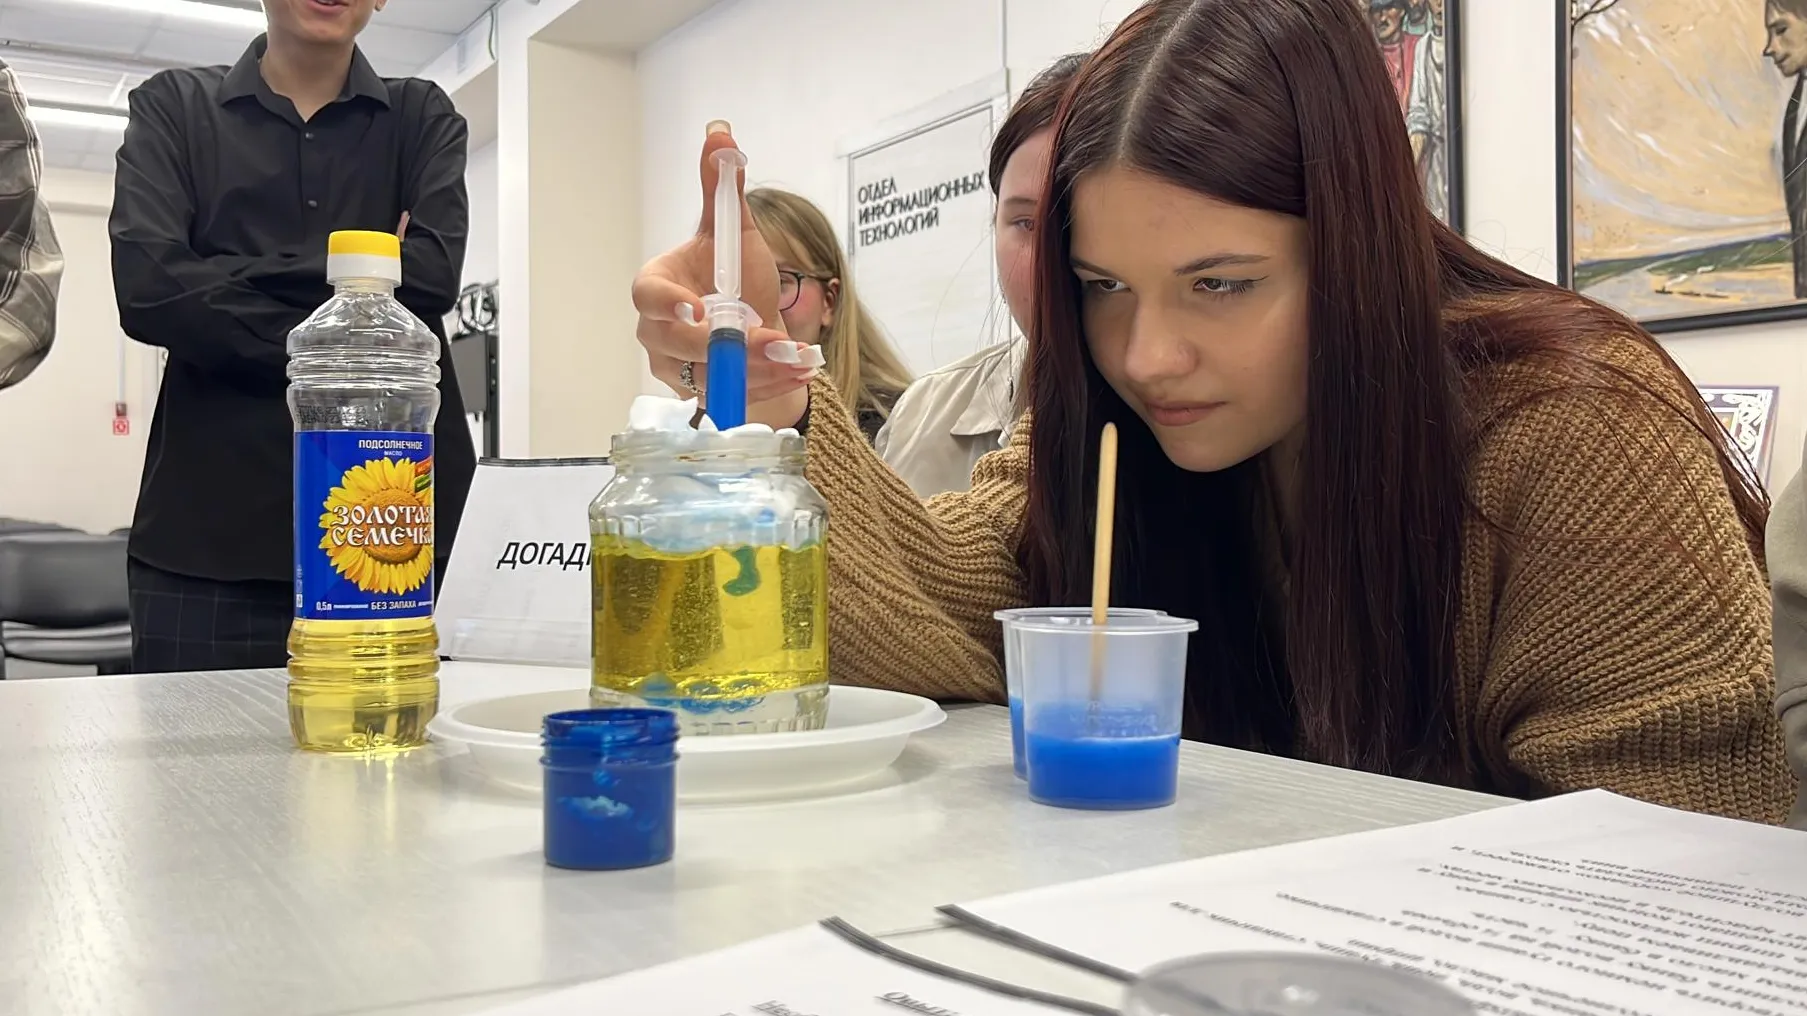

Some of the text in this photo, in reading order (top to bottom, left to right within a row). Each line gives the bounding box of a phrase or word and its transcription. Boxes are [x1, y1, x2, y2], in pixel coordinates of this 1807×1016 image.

[858, 177, 897, 204] ОТДЕЛ
[859, 170, 985, 226] ИНФОРМАЦИОННЫХ
[860, 206, 939, 247] ТЕХНОЛОГИЙ
[358, 439, 423, 450] ПОДСОЛНЕЧНОЕ
[496, 542, 591, 571] ДОГАД
[371, 601, 387, 611] БЕЗ
[389, 600, 417, 610] ЗАПАХА
